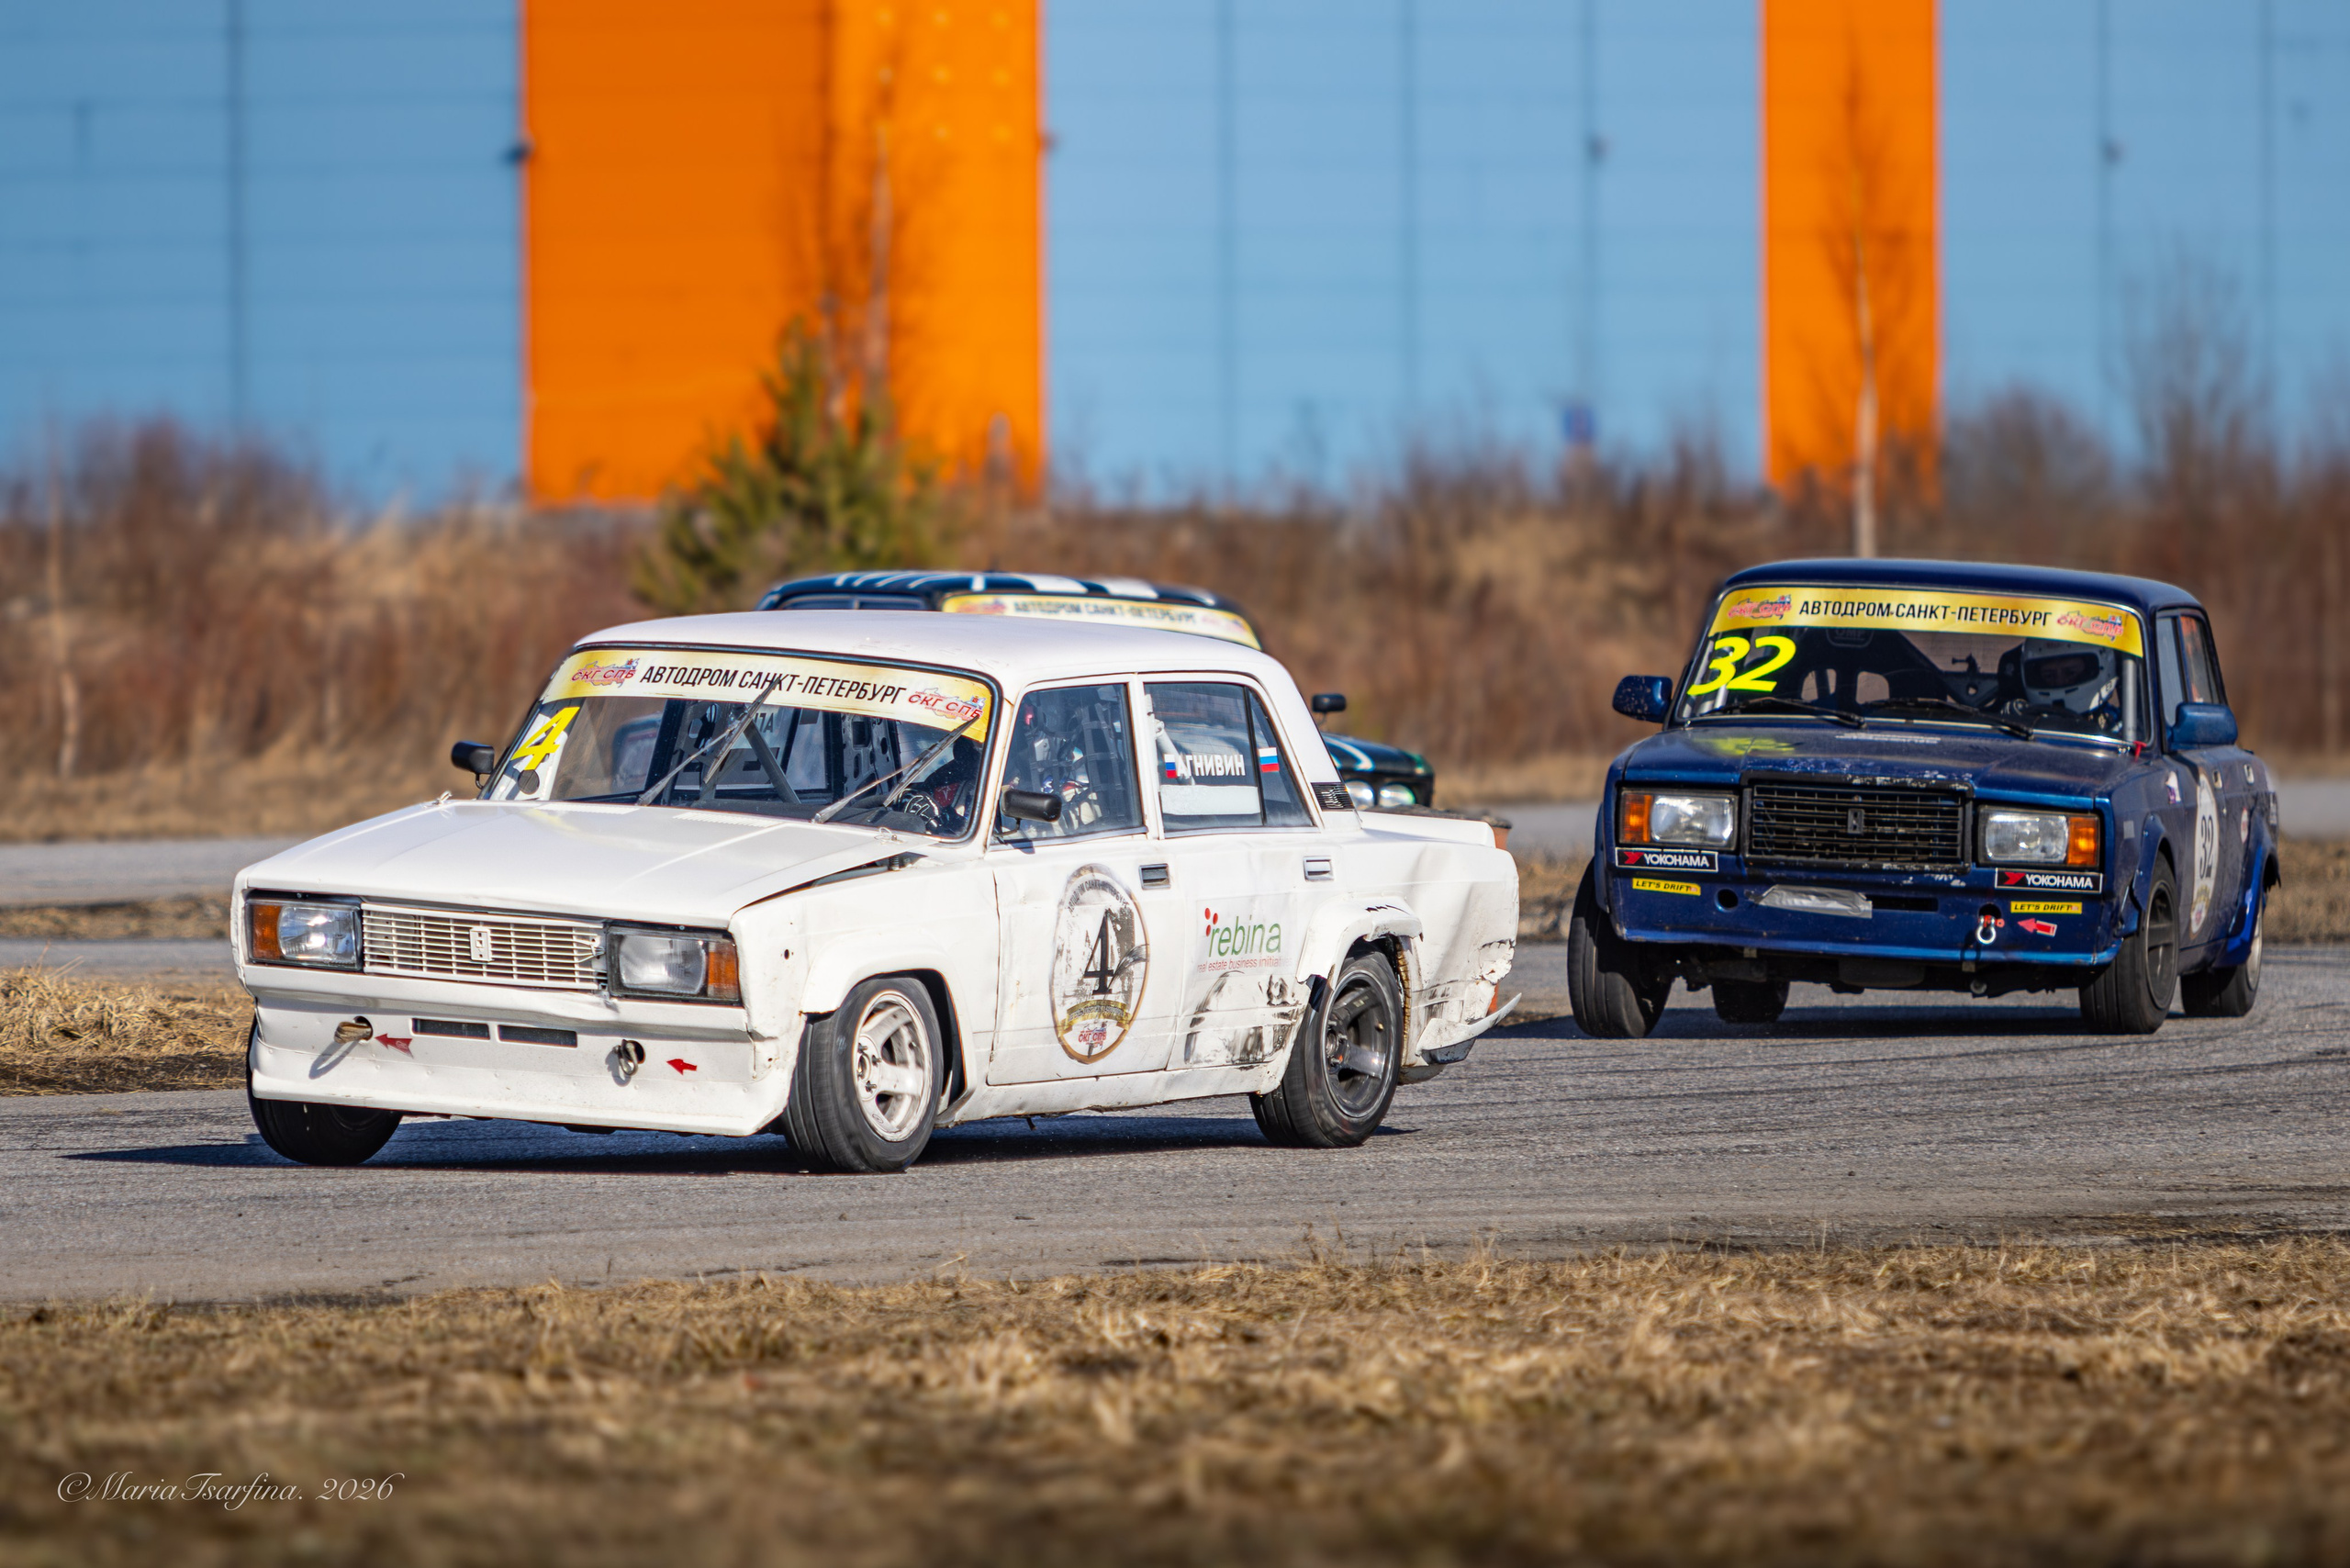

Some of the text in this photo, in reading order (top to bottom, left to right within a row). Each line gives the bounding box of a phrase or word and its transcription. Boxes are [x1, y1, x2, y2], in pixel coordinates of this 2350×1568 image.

[1799, 600, 2053, 627] АВТОДРОМ САНКТ-ПЕТЕРБУРГ
[571, 669, 602, 681] СКГ
[602, 669, 637, 679] СПБ
[1686, 635, 1796, 696] 32
[640, 666, 907, 704] АВТОДРОМ САНКТ-ПЕТЕРБУРГ
[908, 694, 944, 708] СКГ
[945, 701, 983, 719] СПБ
[510, 706, 580, 770] 4
[1176, 754, 1246, 778] АГНИВИН
[2199, 815, 2214, 879] 32
[1644, 853, 1710, 868] YOKOHAMA
[1636, 880, 1661, 889] LET'S
[1663, 881, 1690, 891] DRIFT
[2025, 873, 2094, 890] YOKOHAMA
[2043, 903, 2072, 912] DRIFT
[1208, 914, 1281, 958] rebina
[1083, 908, 1114, 996] 4
[1208, 959, 1227, 971] estate
[1228, 957, 1258, 969] business
